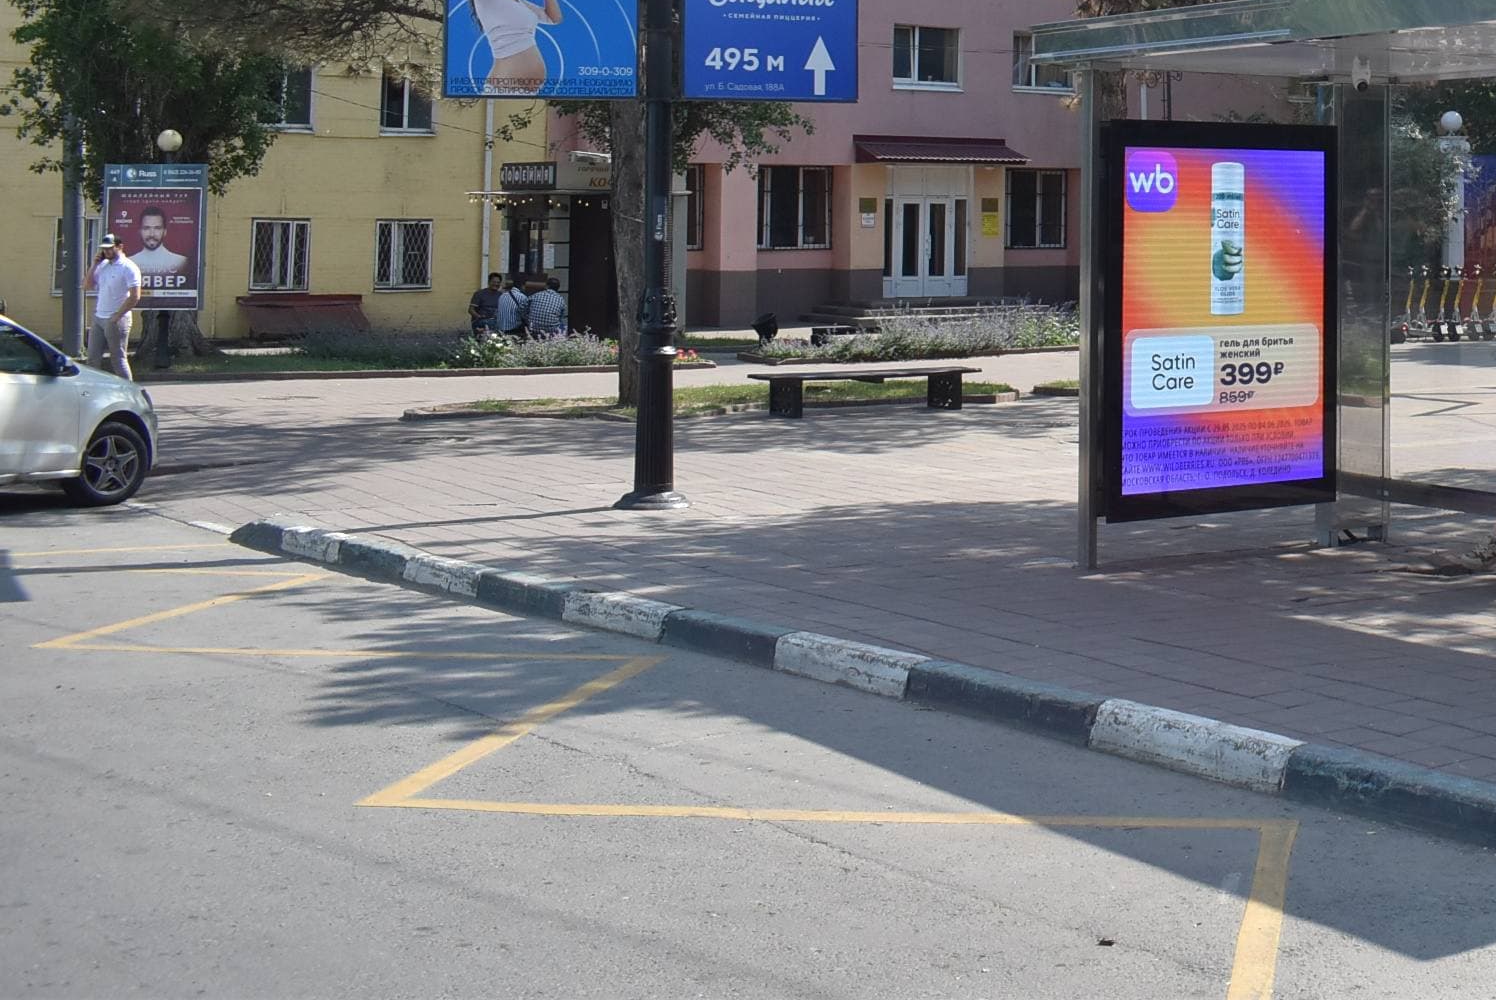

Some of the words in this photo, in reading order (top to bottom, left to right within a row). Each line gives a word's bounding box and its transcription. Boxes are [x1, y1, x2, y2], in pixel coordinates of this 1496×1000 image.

[728, 12, 771, 20] СЕМЕЙНАЯ
[774, 14, 816, 22] ПИЦЦЕРИЯ
[704, 47, 760, 71] 495
[578, 66, 633, 76] 309-0-309
[1130, 163, 1174, 194] wb
[1216, 208, 1240, 219] Satin
[1216, 219, 1240, 229] Care
[142, 275, 187, 288] ЯВЕР
[1219, 339, 1241, 348] гель
[1242, 338, 1260, 348] для
[1261, 336, 1294, 348] бритья
[1219, 348, 1261, 359] женский
[1151, 353, 1196, 371] Satin
[1152, 373, 1194, 391] Care
[1122, 453, 1132, 462] ТО
[1157, 449, 1186, 459] ИМЕЕТСЯ
[1122, 465, 1139, 474] АЙТЕ
